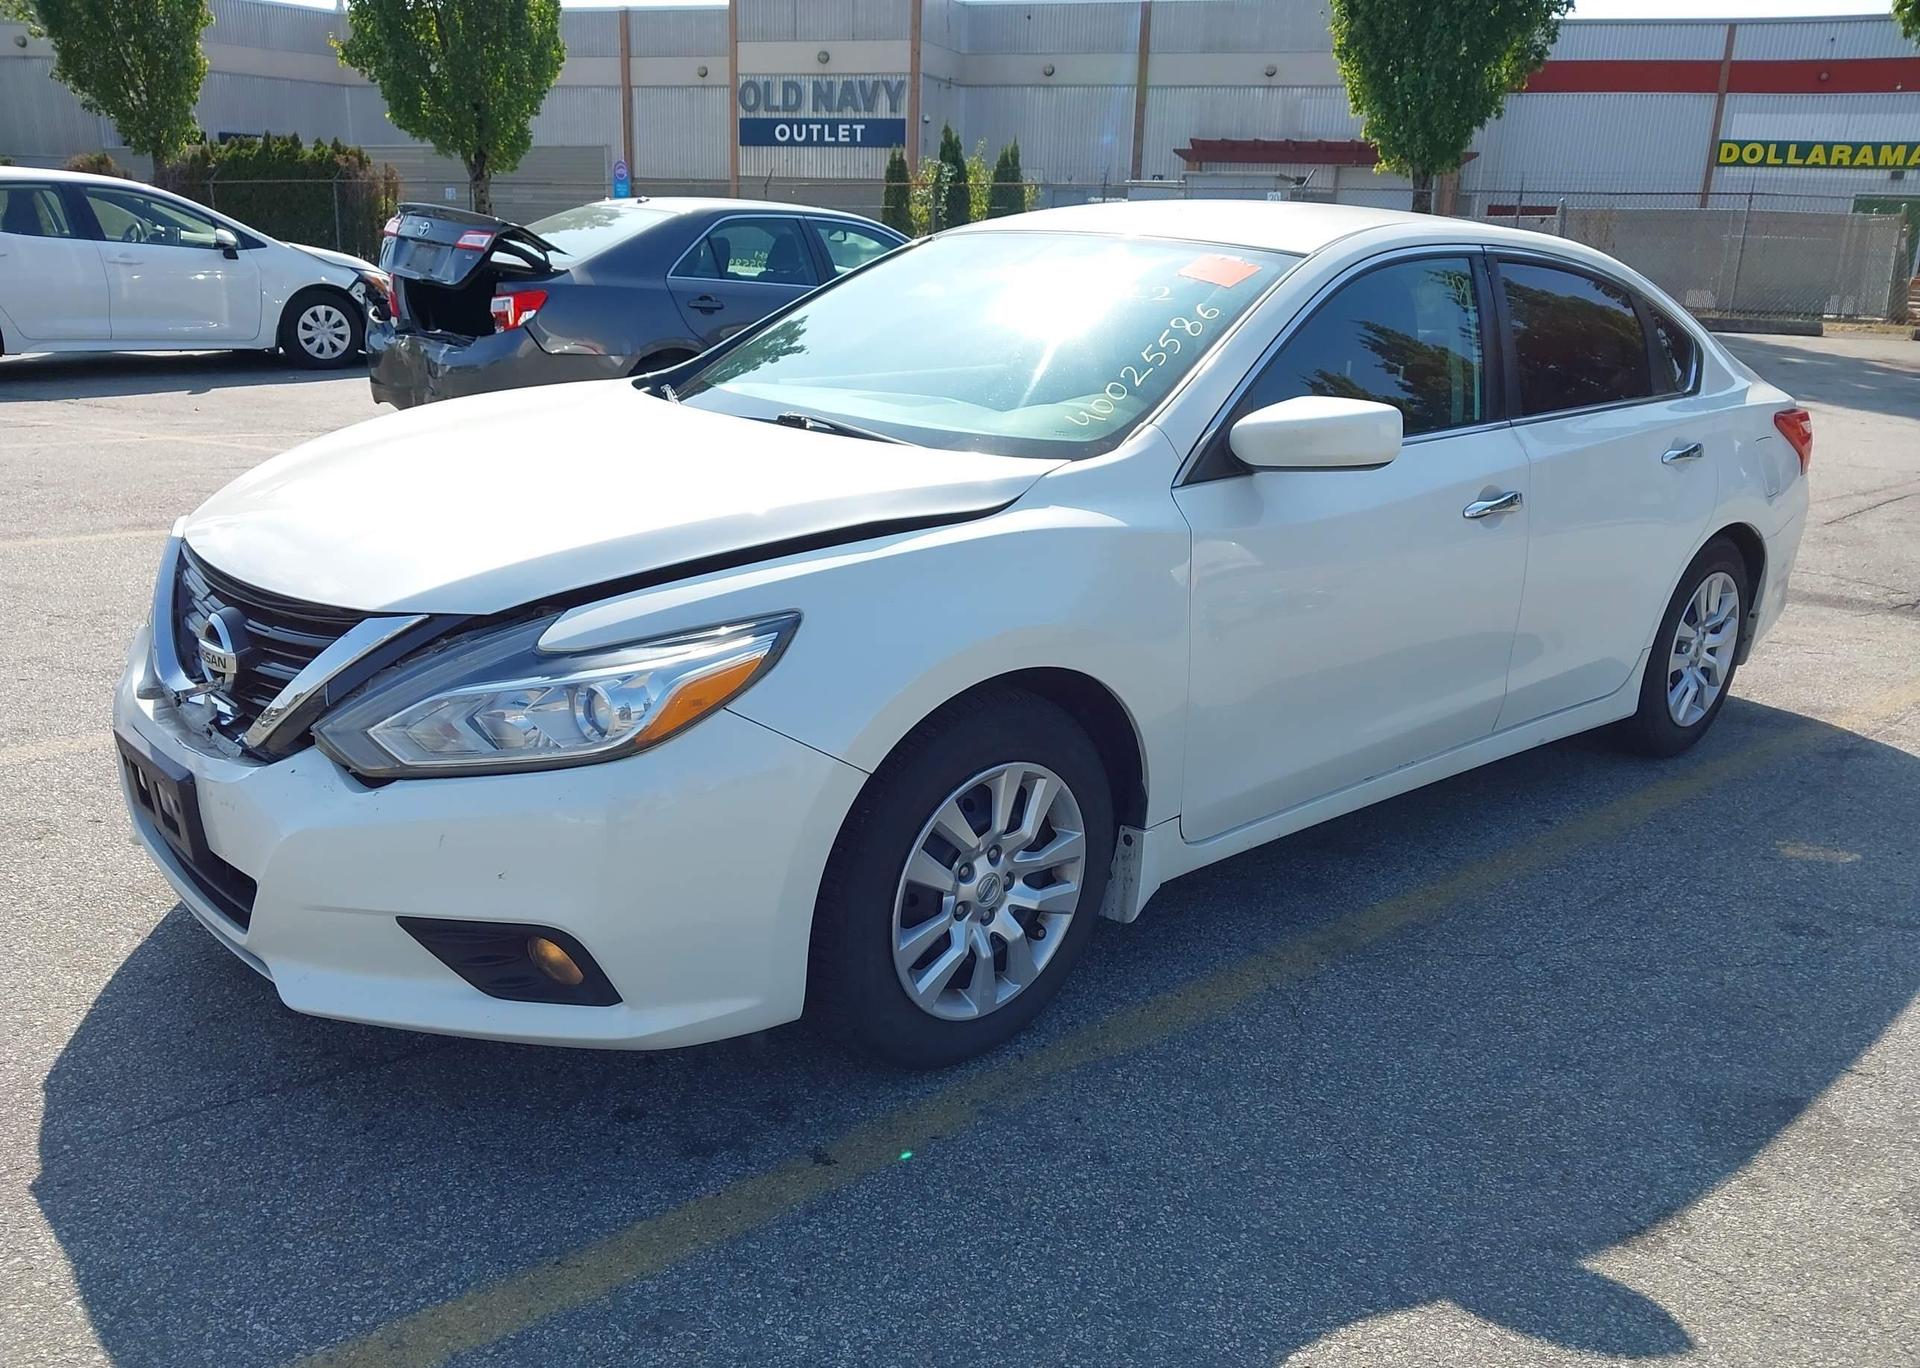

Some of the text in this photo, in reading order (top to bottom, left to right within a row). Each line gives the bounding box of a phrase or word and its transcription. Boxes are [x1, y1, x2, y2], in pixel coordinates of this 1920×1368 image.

[738, 80, 907, 114] OLD NAVY
[774, 123, 866, 143] OUTLET
[1064, 303, 1221, 426] 40025586
